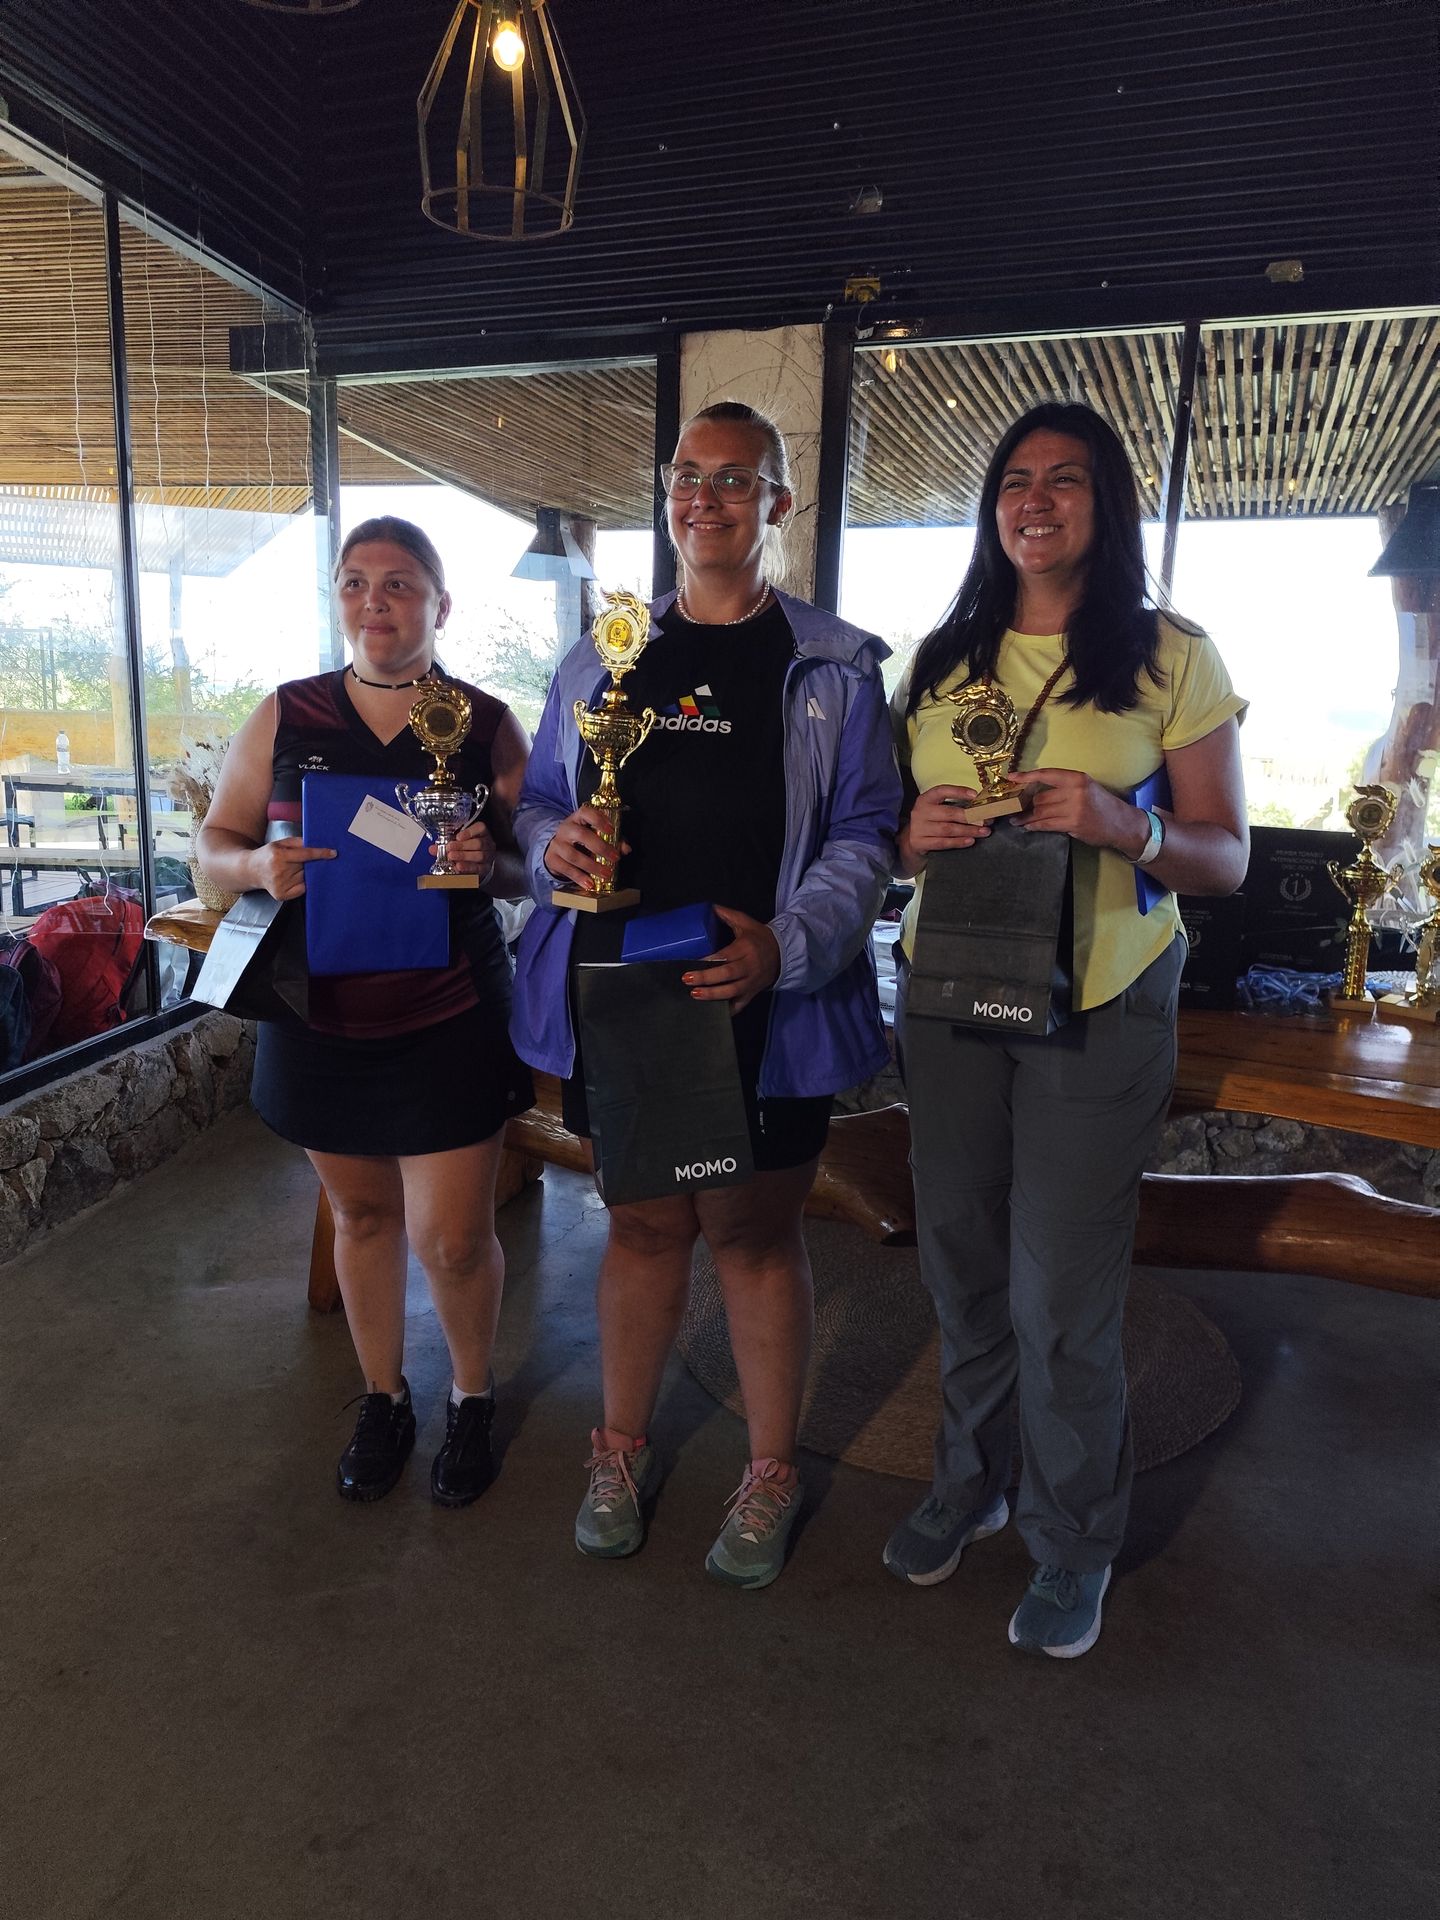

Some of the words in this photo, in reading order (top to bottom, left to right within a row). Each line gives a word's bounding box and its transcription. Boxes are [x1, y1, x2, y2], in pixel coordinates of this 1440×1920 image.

[653, 714, 732, 733] adidas
[973, 1001, 1033, 1022] MOMO
[675, 1157, 737, 1181] MOMO
